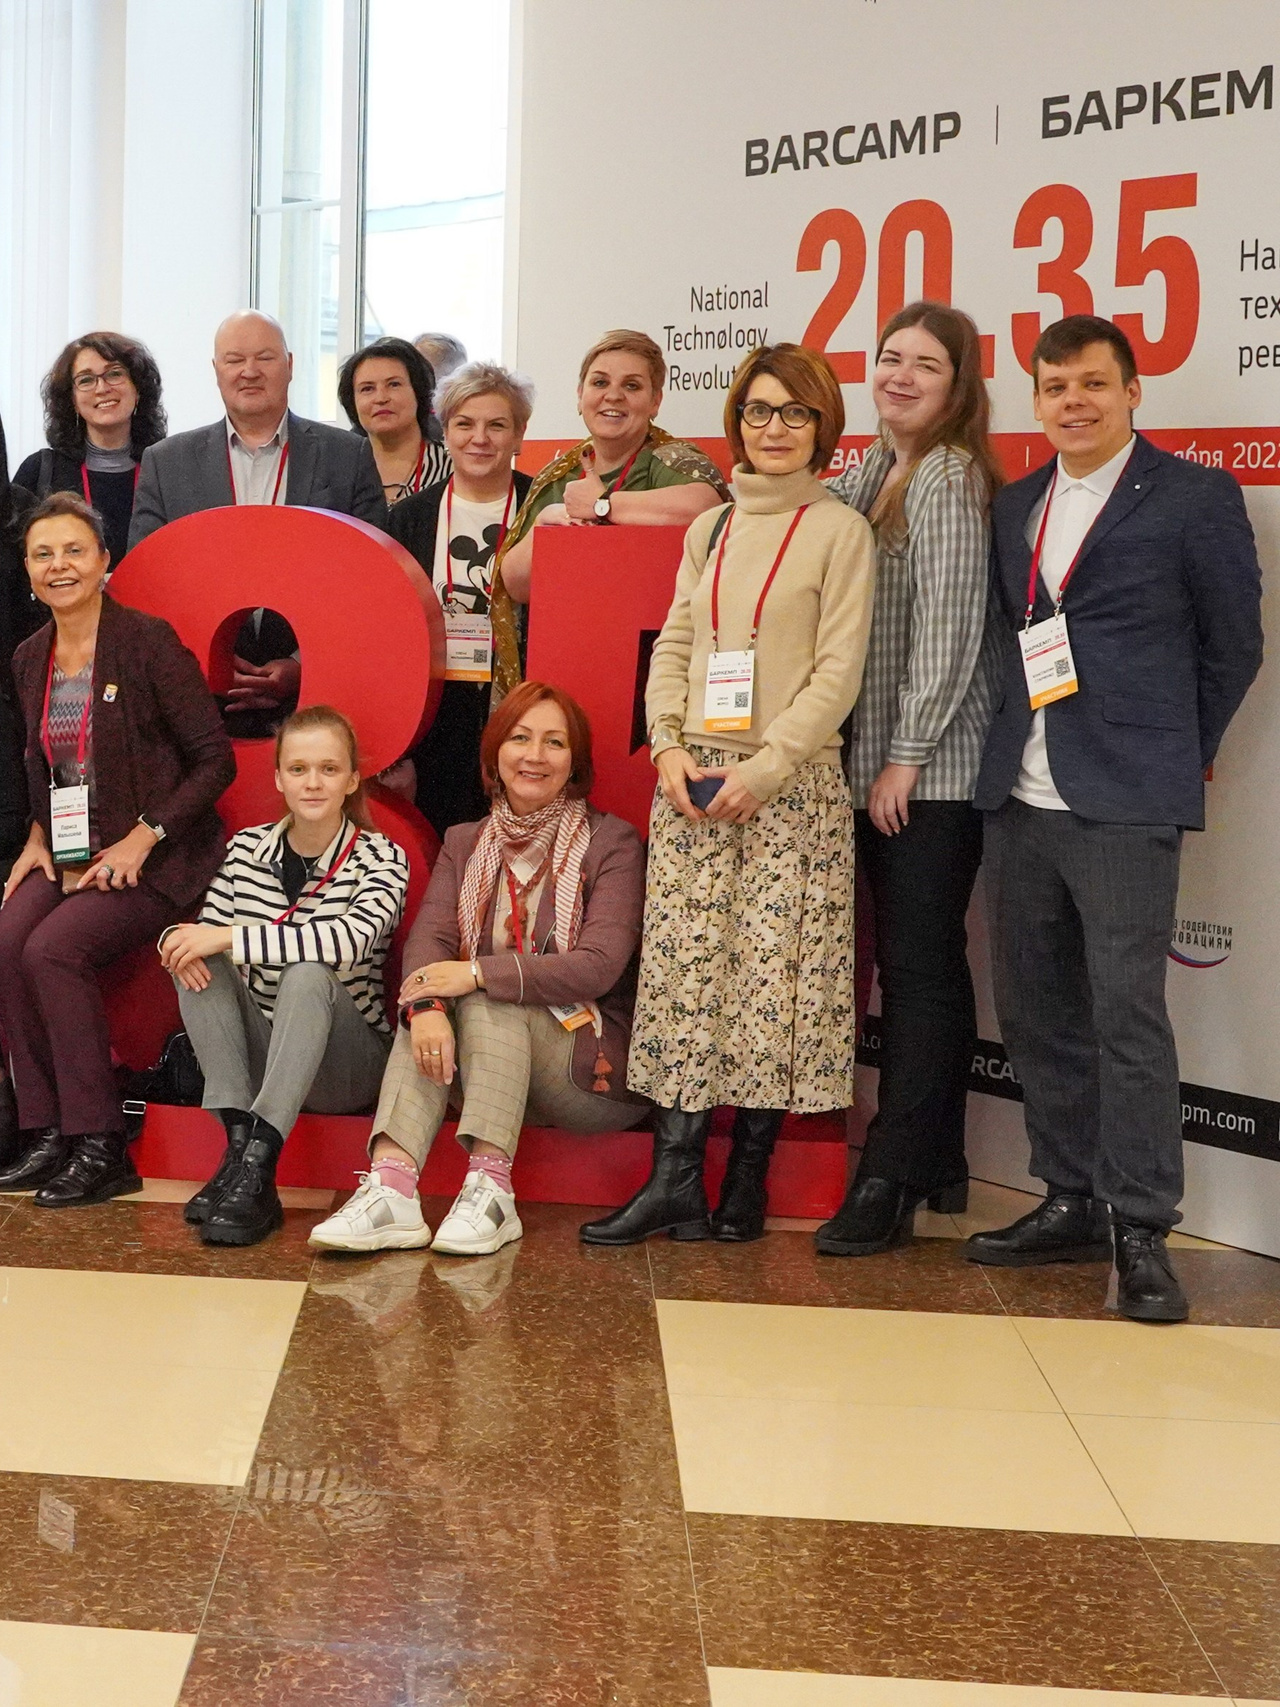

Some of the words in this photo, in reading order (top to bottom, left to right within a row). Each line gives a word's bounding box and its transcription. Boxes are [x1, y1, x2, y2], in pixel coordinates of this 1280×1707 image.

[1041, 65, 1273, 139] БАРКЕМ
[745, 111, 962, 177] BARCAMP
[1240, 238, 1280, 272] На
[690, 281, 769, 313] National
[1232, 441, 1280, 469] 202
[1181, 920, 1233, 936] СОДЕЙСТВИЯ
